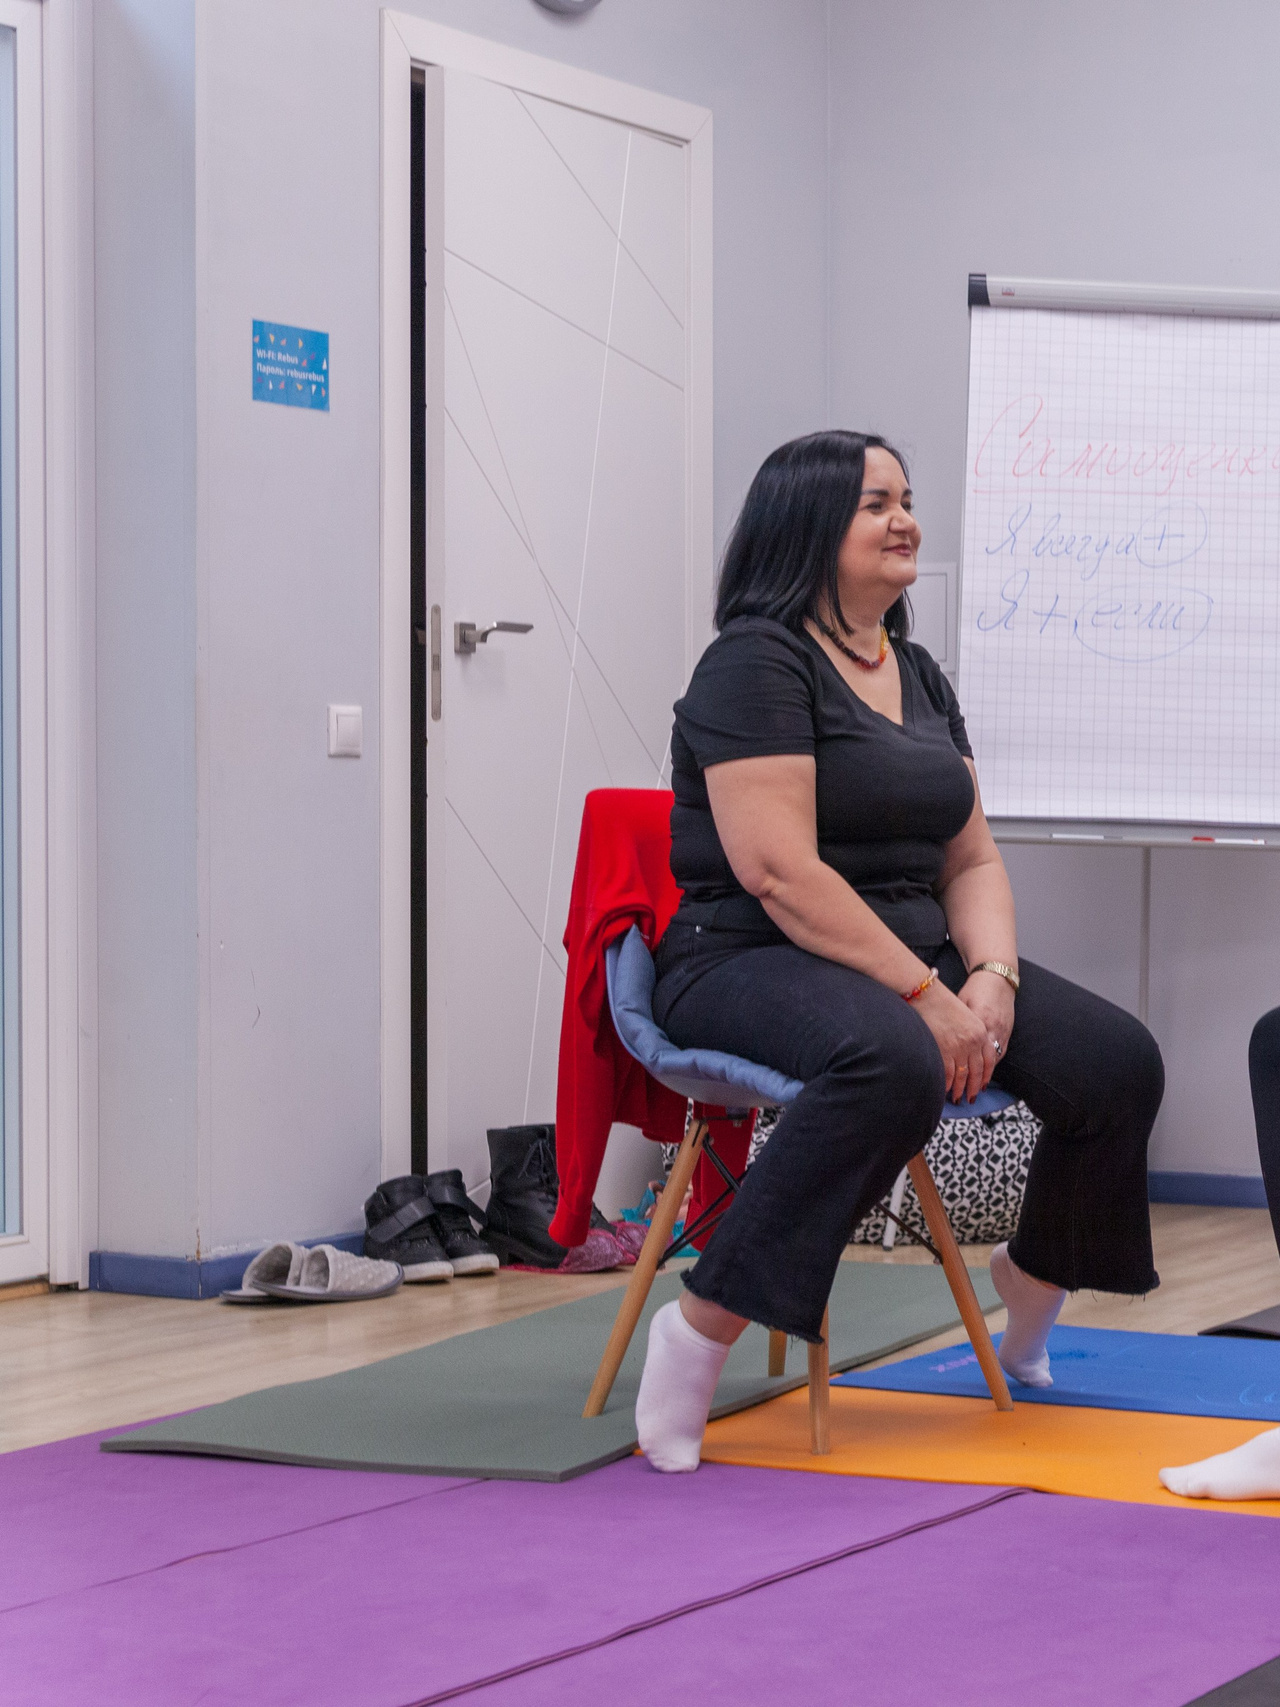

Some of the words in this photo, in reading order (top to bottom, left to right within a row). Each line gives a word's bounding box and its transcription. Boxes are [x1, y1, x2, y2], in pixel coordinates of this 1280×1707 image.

[256, 362, 286, 377] Пароль:
[286, 368, 325, 383] rebusrebus
[277, 351, 299, 365] Rebus
[985, 502, 1032, 556] Я
[1032, 512, 1136, 582] всегда
[976, 568, 1030, 632] Я
[1090, 601, 1186, 631] если
